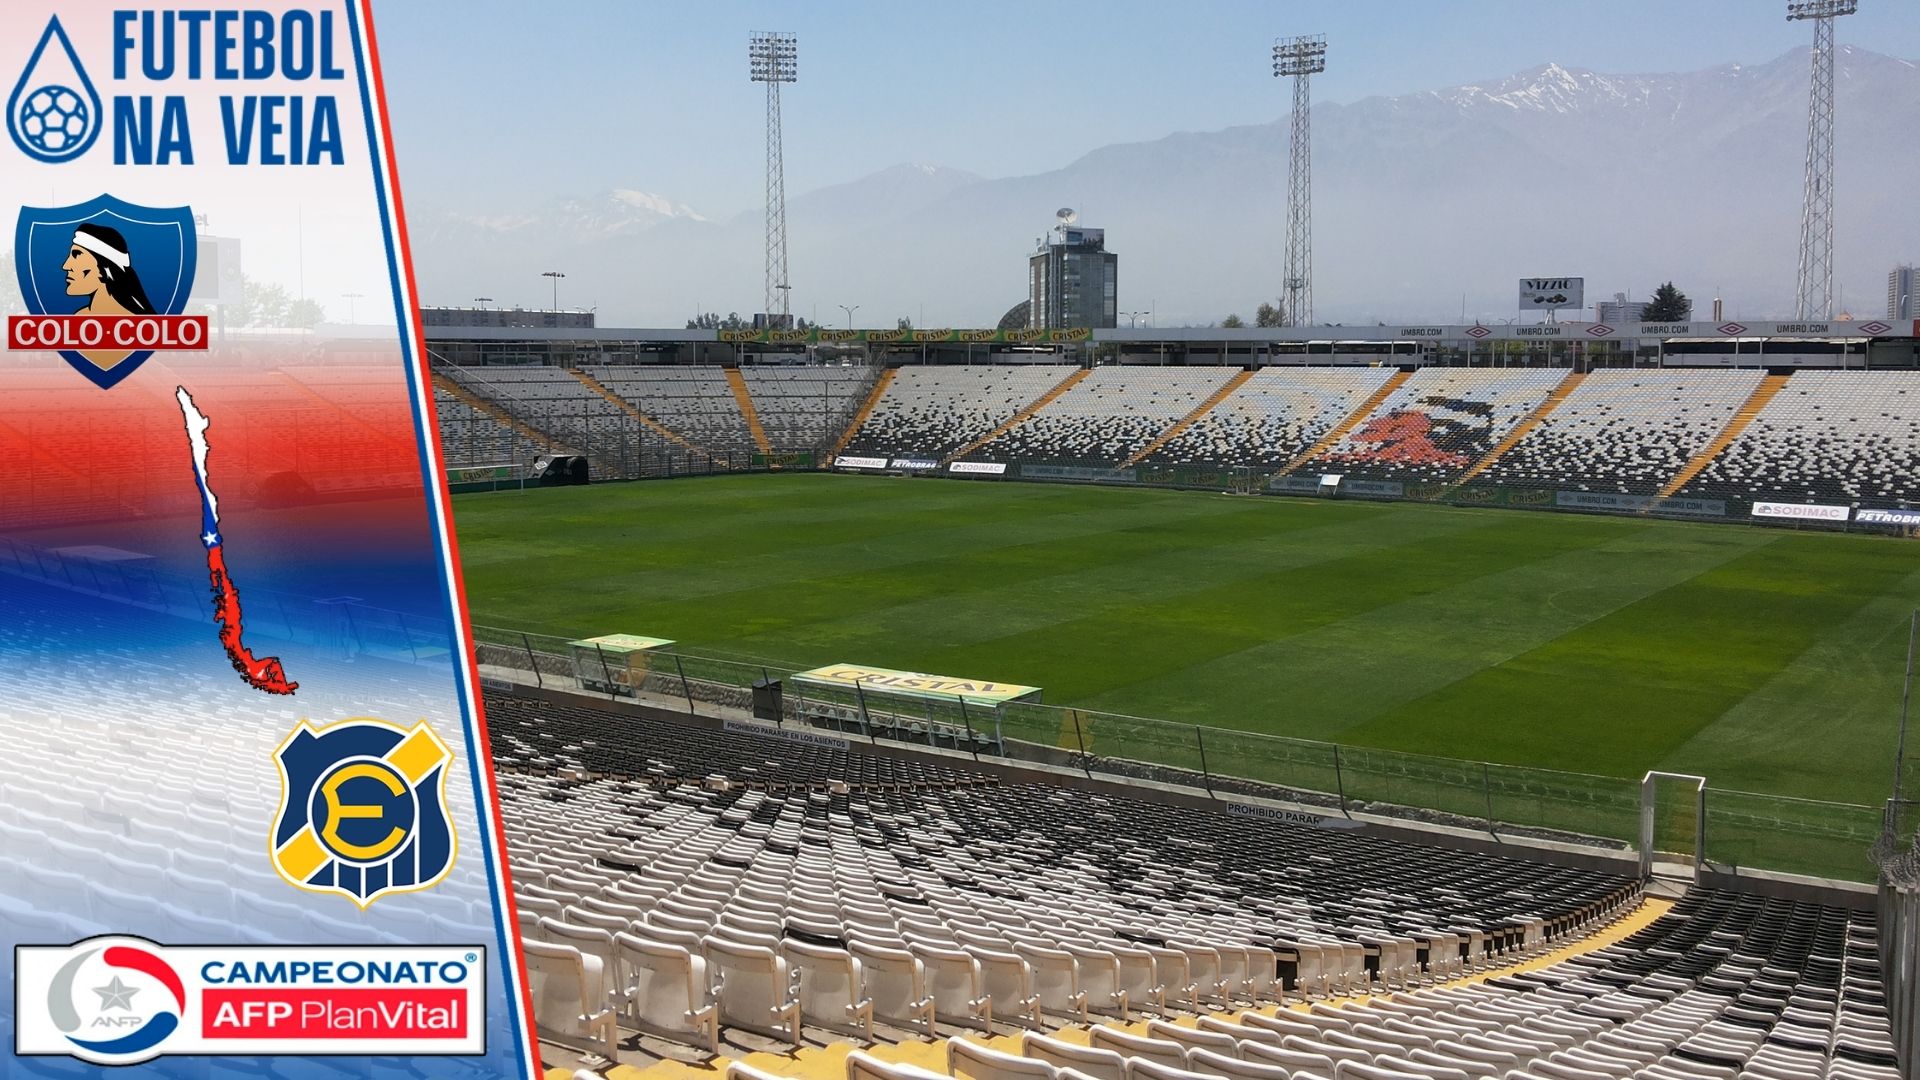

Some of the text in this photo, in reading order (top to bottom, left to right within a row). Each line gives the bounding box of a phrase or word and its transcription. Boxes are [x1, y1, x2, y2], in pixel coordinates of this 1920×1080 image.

[1527, 280, 1572, 290] VIZZIO
[724, 328, 761, 341] CRISTAL
[772, 328, 808, 341] CRISTAL
[821, 328, 857, 341] CRISTAL
[869, 328, 904, 341] CRISTAL
[916, 328, 950, 341] CRISTAL
[962, 328, 996, 341] CRISTAL
[1007, 328, 1042, 341] CRISTAL
[1053, 328, 1088, 341] CRISTAL
[1401, 328, 1442, 336] UMBRO.COM
[1516, 327, 1561, 336] UMBRO.COM
[1641, 325, 1689, 334] UMBRO.COM
[1776, 324, 1829, 333] UMBRO.COM
[463, 468, 493, 480] CRISTAL
[1460, 488, 1495, 500] CRISTAL
[1512, 492, 1548, 503] CRISTAL
[1773, 506, 1840, 518] SODIMAC
[831, 670, 1007, 693] CRISTAL
[790, 732, 800, 740] EN
[801, 734, 813, 742] LOS
[814, 736, 846, 748] ASIENTOS
[1228, 803, 1283, 819] PROHIBIDO
